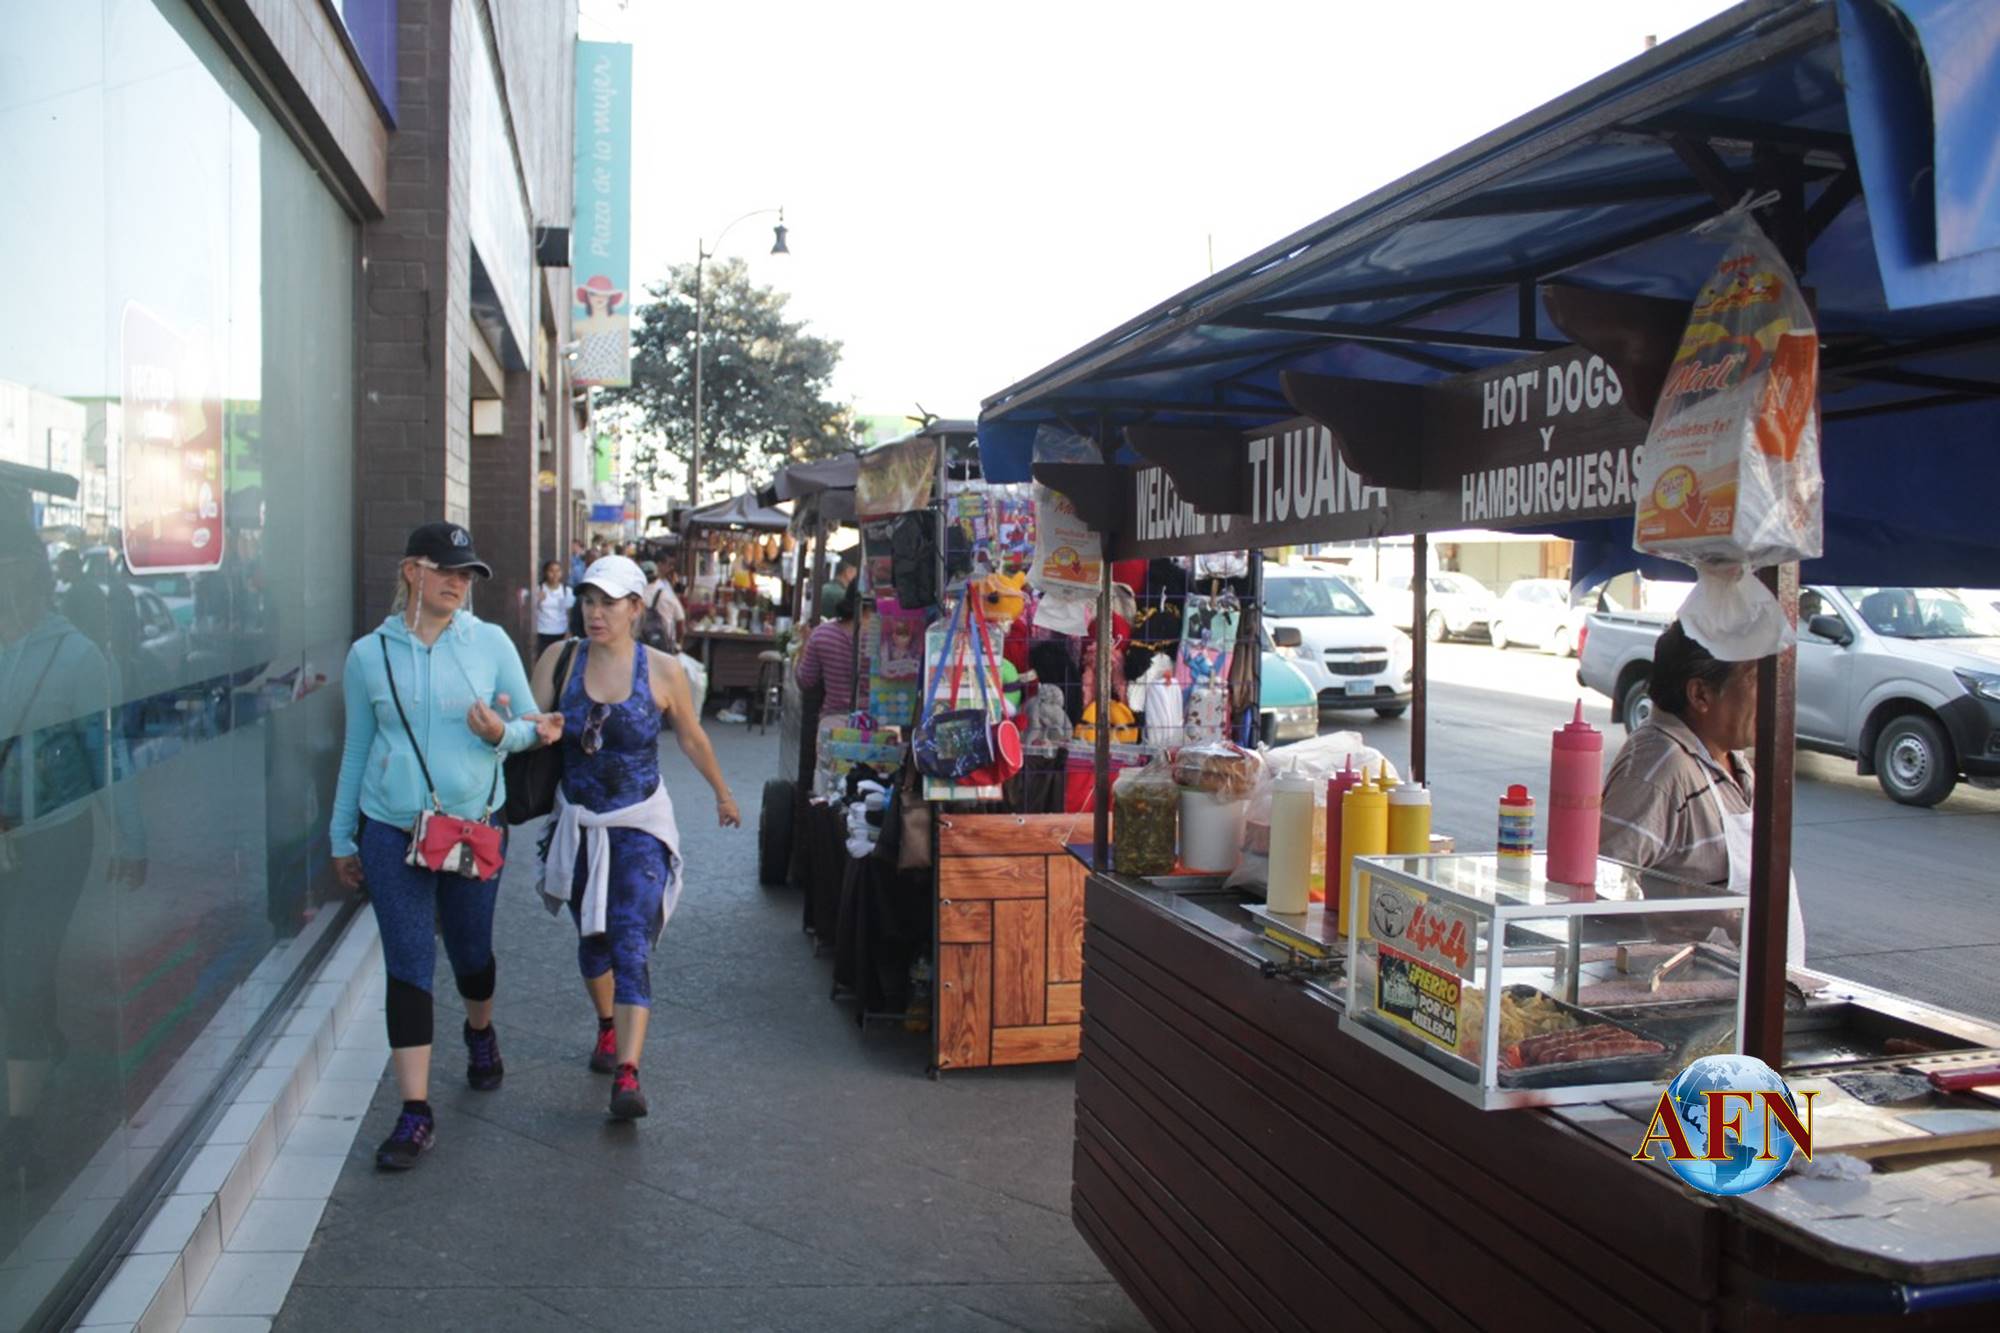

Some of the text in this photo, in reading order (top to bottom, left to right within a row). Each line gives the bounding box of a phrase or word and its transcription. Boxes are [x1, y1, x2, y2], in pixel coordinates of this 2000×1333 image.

[590, 55, 617, 257] Plaza de la mujer
[1248, 425, 1387, 523] TIJUAN
[1540, 425, 1555, 452] Y
[1137, 466, 1205, 540] WELCO
